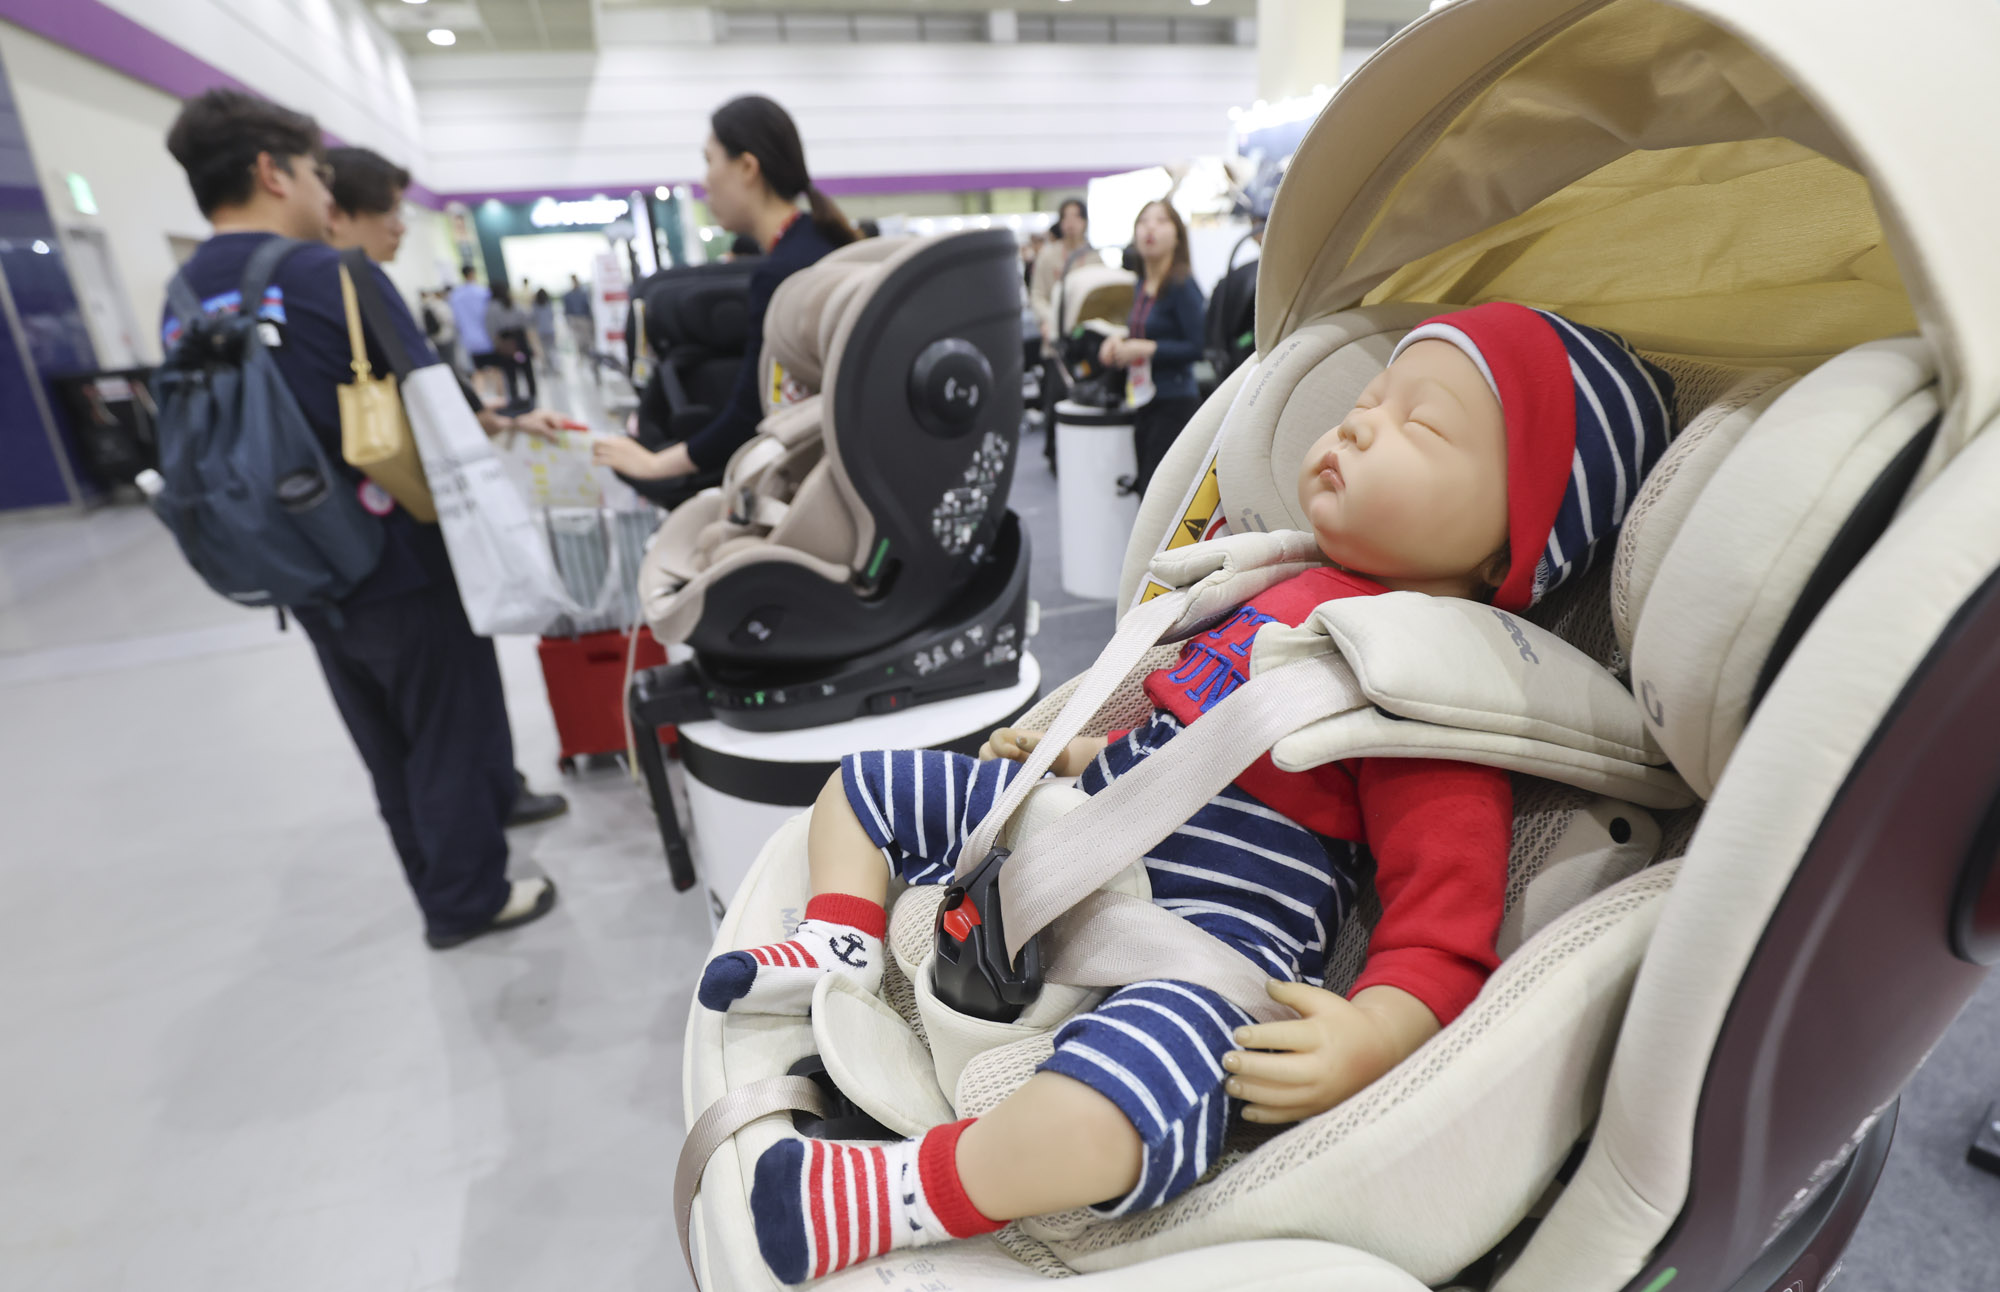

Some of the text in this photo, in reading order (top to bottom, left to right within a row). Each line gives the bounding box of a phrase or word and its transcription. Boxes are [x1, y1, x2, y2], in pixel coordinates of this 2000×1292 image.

[1248, 370, 1273, 407] BUMPER
[1208, 606, 1279, 657] TT
[1167, 642, 1248, 714] UN
[780, 908, 799, 939] MA
